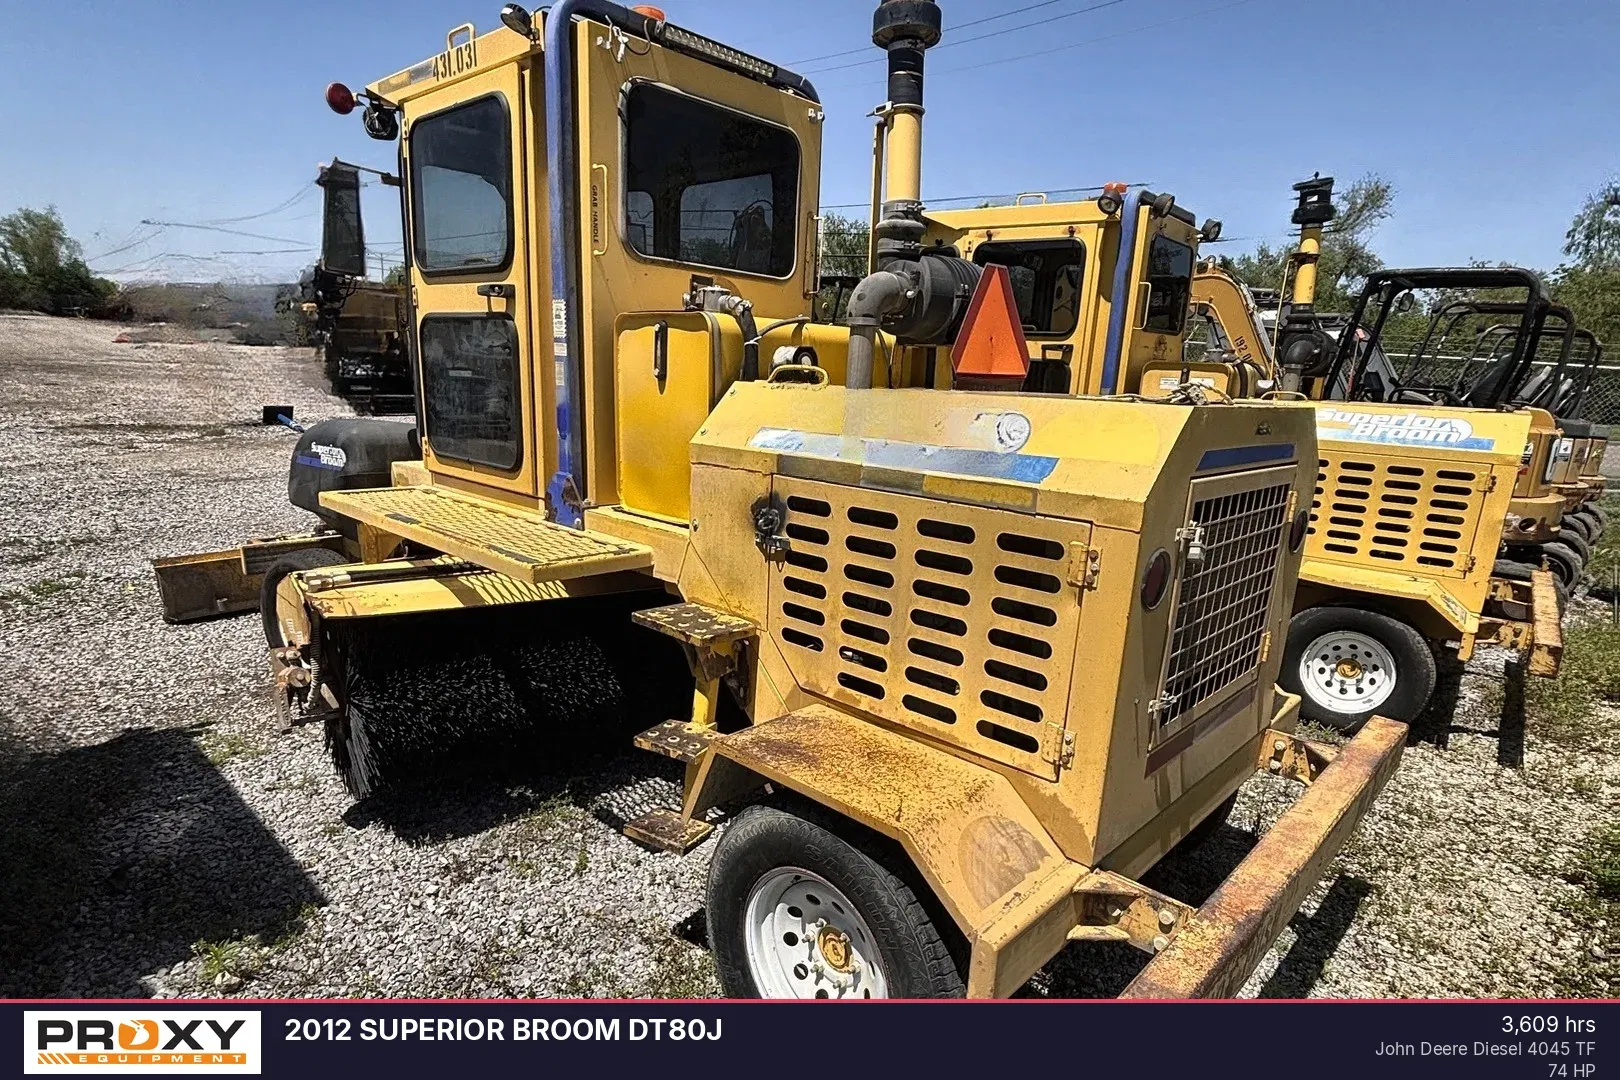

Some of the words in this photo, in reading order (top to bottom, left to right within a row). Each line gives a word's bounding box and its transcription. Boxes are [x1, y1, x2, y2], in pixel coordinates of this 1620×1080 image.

[432, 40, 478, 82] 431.031
[591, 185, 599, 208] GRAB
[592, 211, 600, 244] HANDLE
[1351, 421, 1462, 442] Broom
